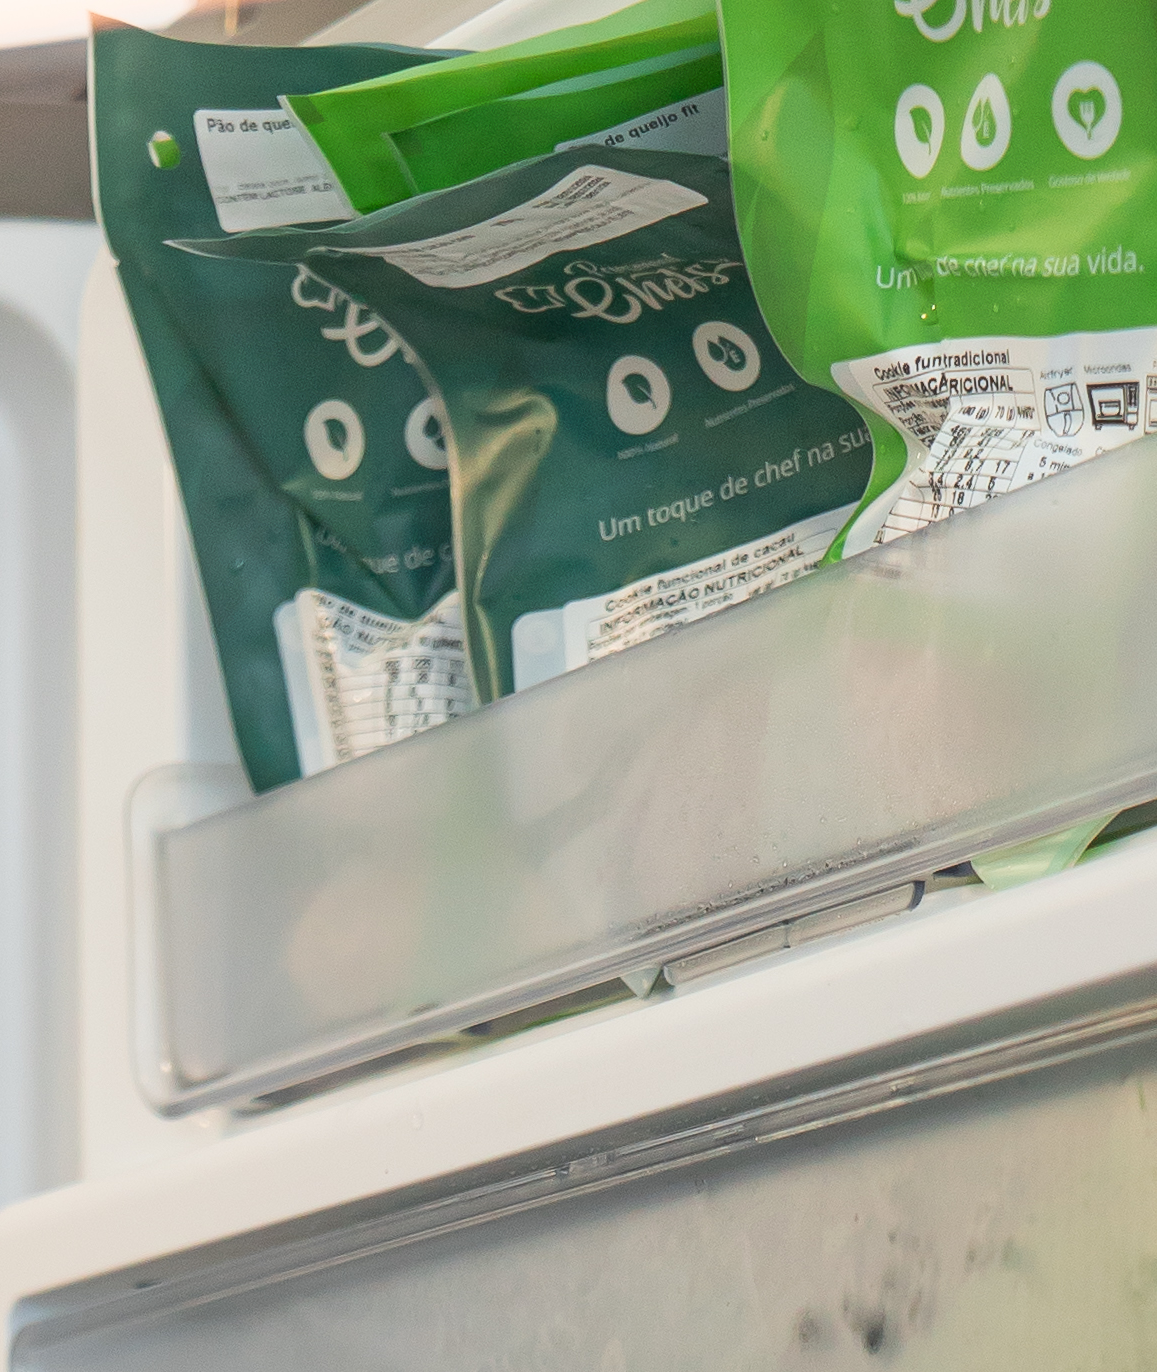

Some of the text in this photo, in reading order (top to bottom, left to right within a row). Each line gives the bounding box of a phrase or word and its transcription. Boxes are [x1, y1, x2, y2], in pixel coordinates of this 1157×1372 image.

[206, 117, 234, 133] Pão
[239, 119, 258, 132] de
[604, 104, 700, 146] de queijo fit
[876, 264, 918, 291] Um
[1042, 255, 1079, 277] sua
[1086, 244, 1145, 276] vida.
[598, 514, 641, 542] Um
[646, 489, 714, 527] toque
[719, 476, 749, 501] de
[754, 448, 803, 489] chef
[807, 442, 835, 467] na
